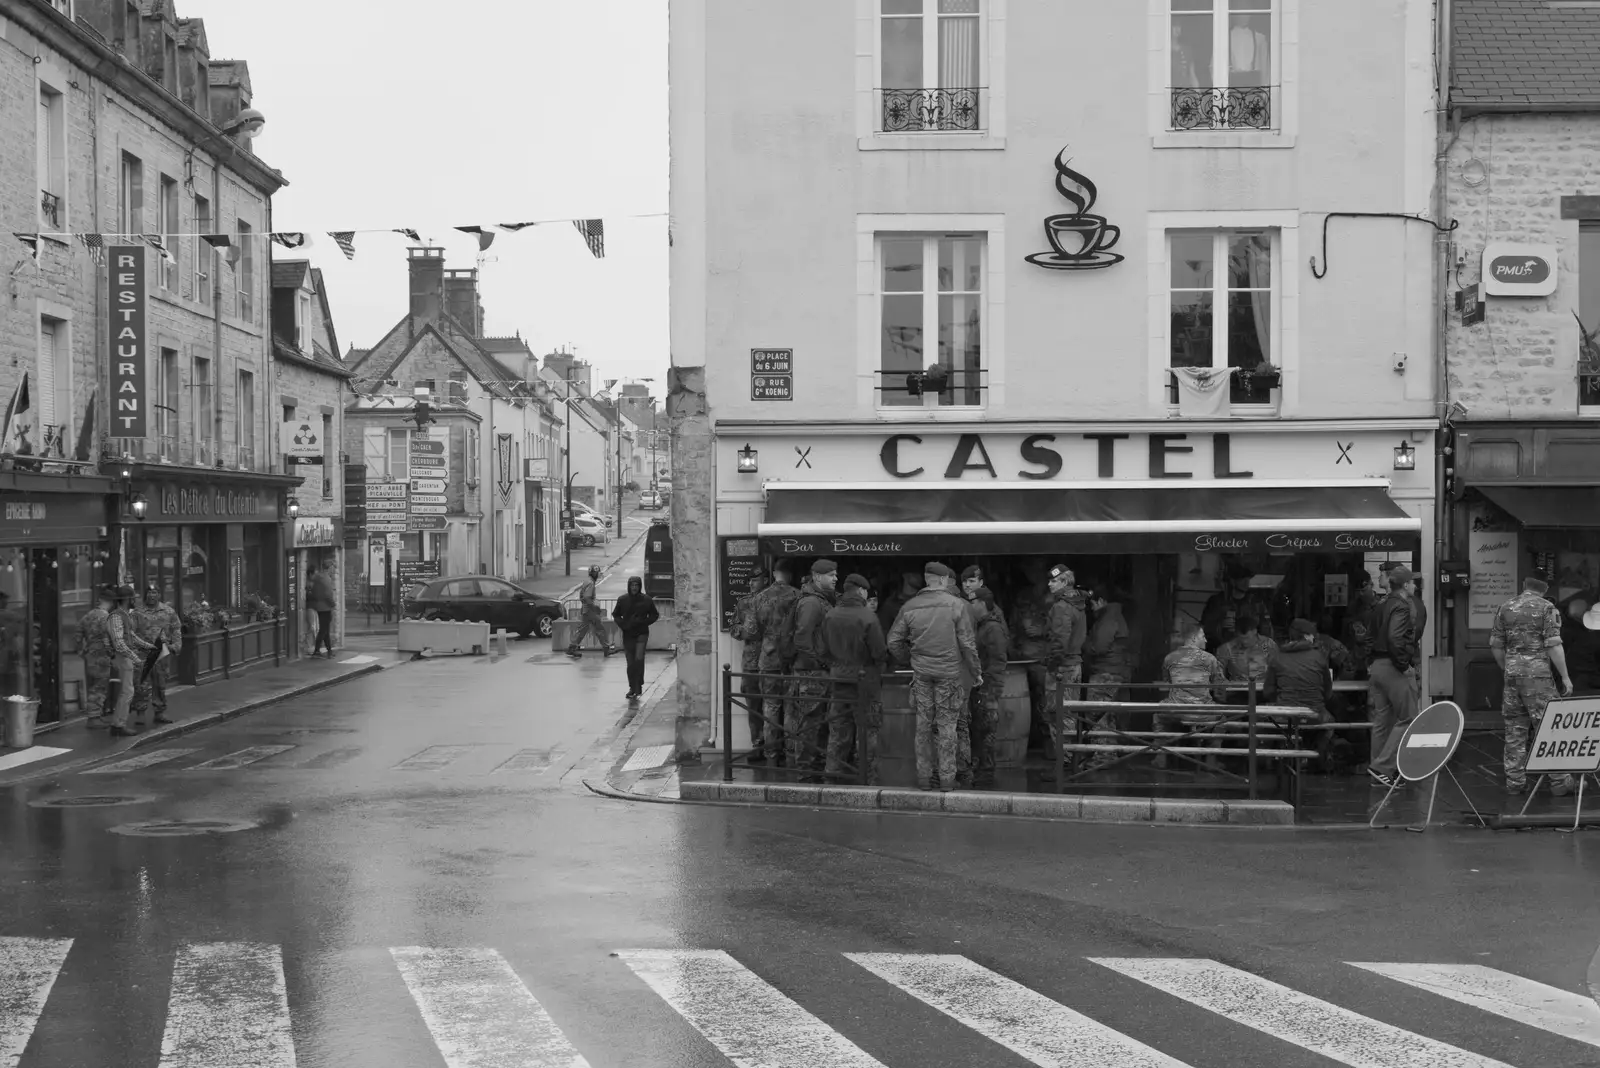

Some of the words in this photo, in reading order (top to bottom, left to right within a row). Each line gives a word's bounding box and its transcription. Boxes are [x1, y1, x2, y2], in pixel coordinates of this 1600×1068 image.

[1496, 265, 1524, 275] PMU
[117, 254, 138, 429] RESTAURANT
[765, 362, 770, 370] 6
[772, 362, 788, 370] JUIN
[765, 388, 788, 396] KOENIG
[879, 433, 1253, 480] CASTEL
[161, 486, 178, 514] Les
[214, 489, 226, 515] du
[228, 489, 260, 515] Cotentin
[781, 538, 814, 553] Bar
[830, 538, 902, 552] Brasserie
[1194, 534, 1249, 551] Glacier
[1265, 533, 1322, 549] Crêpes
[1334, 533, 1394, 550] Gaufres
[1550, 711, 1600, 729] ROUTE
[1536, 736, 1600, 758] BARRÉE
